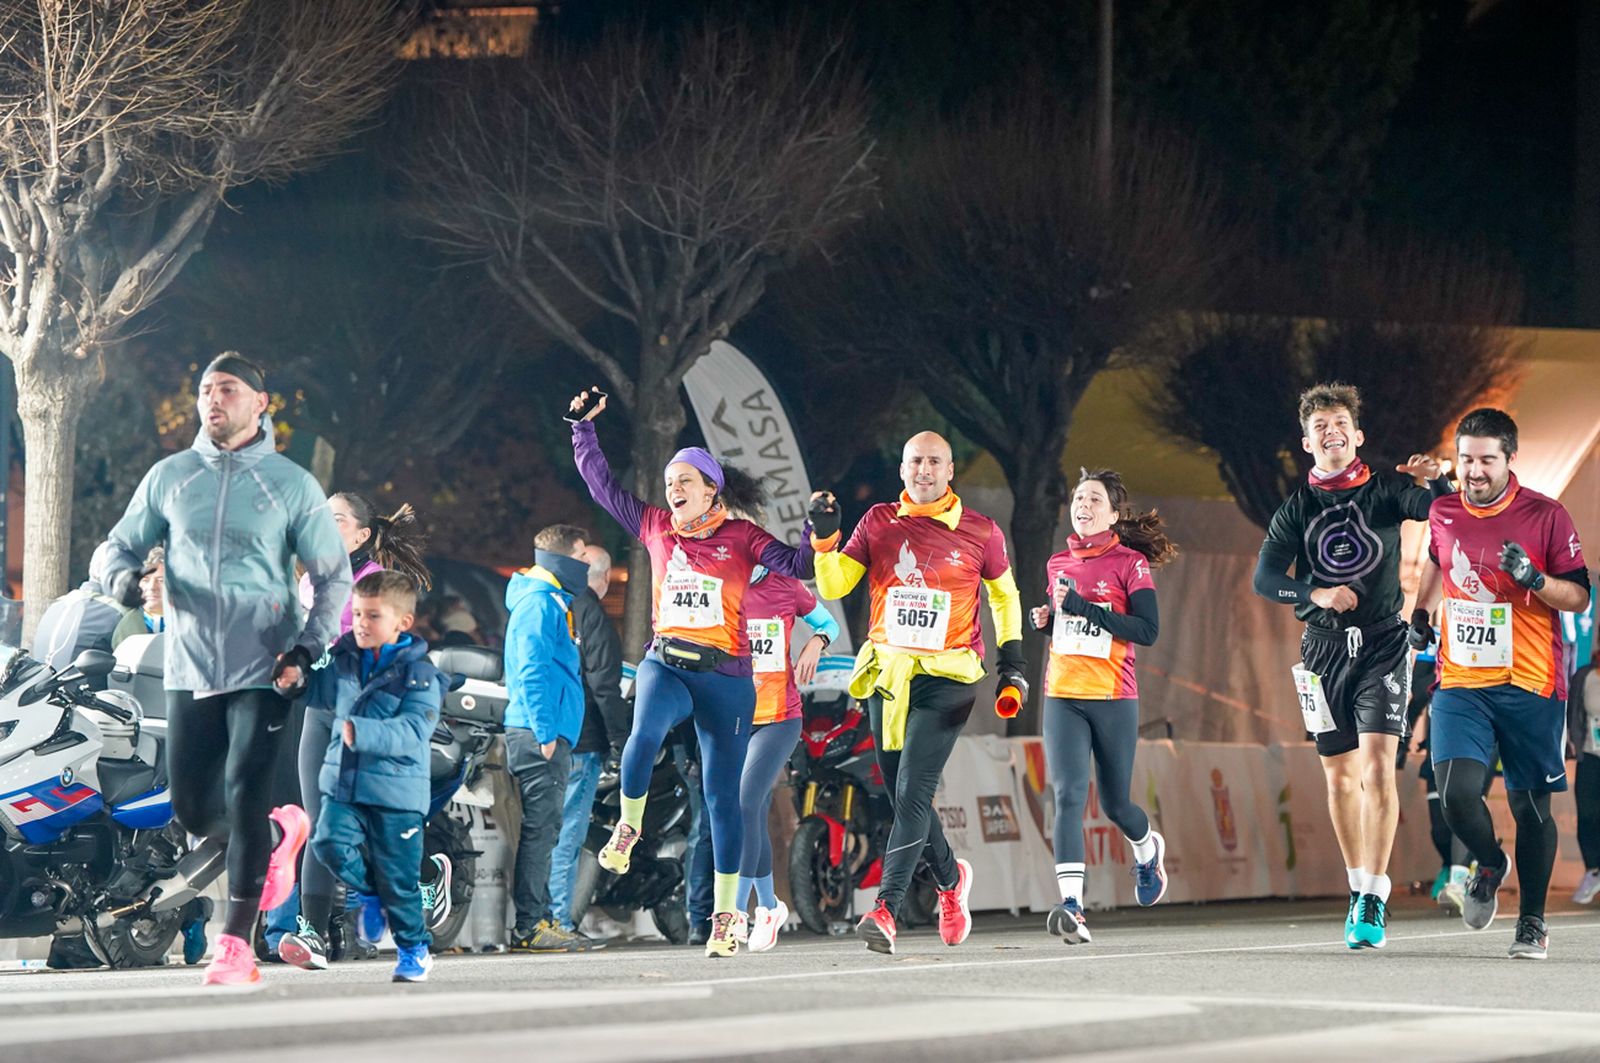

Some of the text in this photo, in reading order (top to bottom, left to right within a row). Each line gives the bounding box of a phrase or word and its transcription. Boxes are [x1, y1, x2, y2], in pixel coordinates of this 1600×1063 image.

[1461, 575, 1481, 595] 43
[672, 591, 710, 609] 4424
[897, 608, 938, 629] 5057
[1456, 623, 1497, 646] 5274
